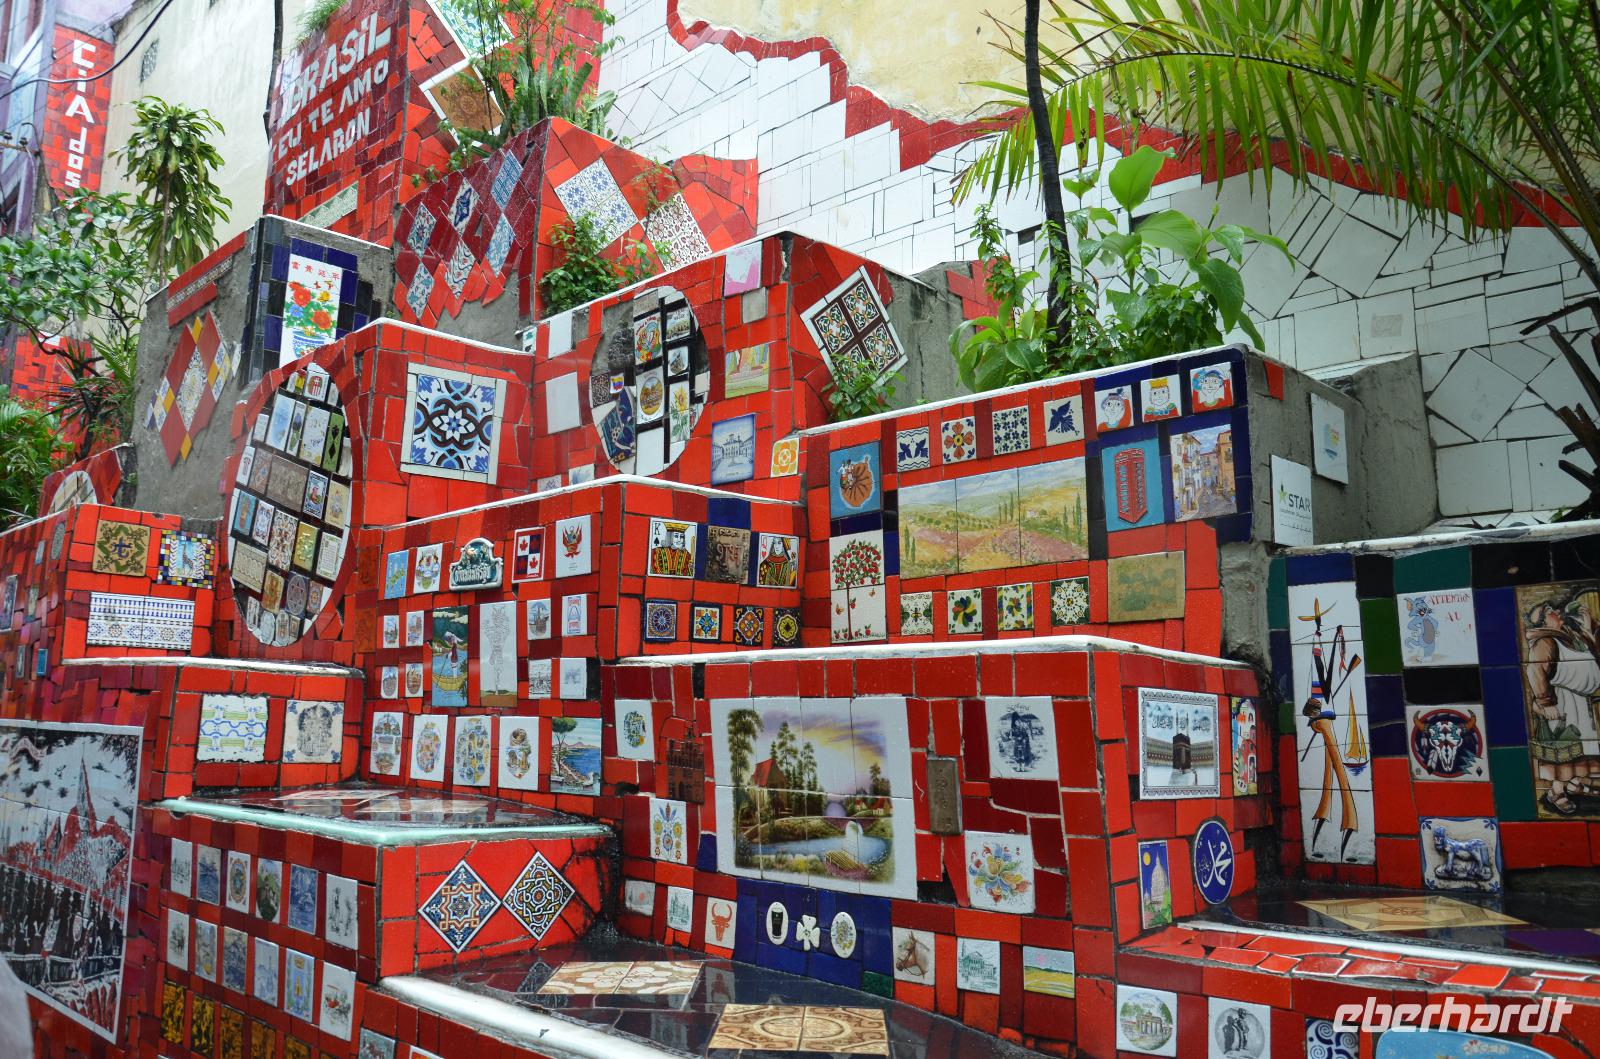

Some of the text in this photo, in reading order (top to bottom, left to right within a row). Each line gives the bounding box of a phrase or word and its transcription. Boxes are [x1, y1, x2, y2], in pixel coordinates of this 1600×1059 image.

[308, 98, 334, 133] TE
[339, 59, 389, 114] AMO
[286, 107, 370, 186] SELARON
[1288, 493, 1311, 513] STAR
